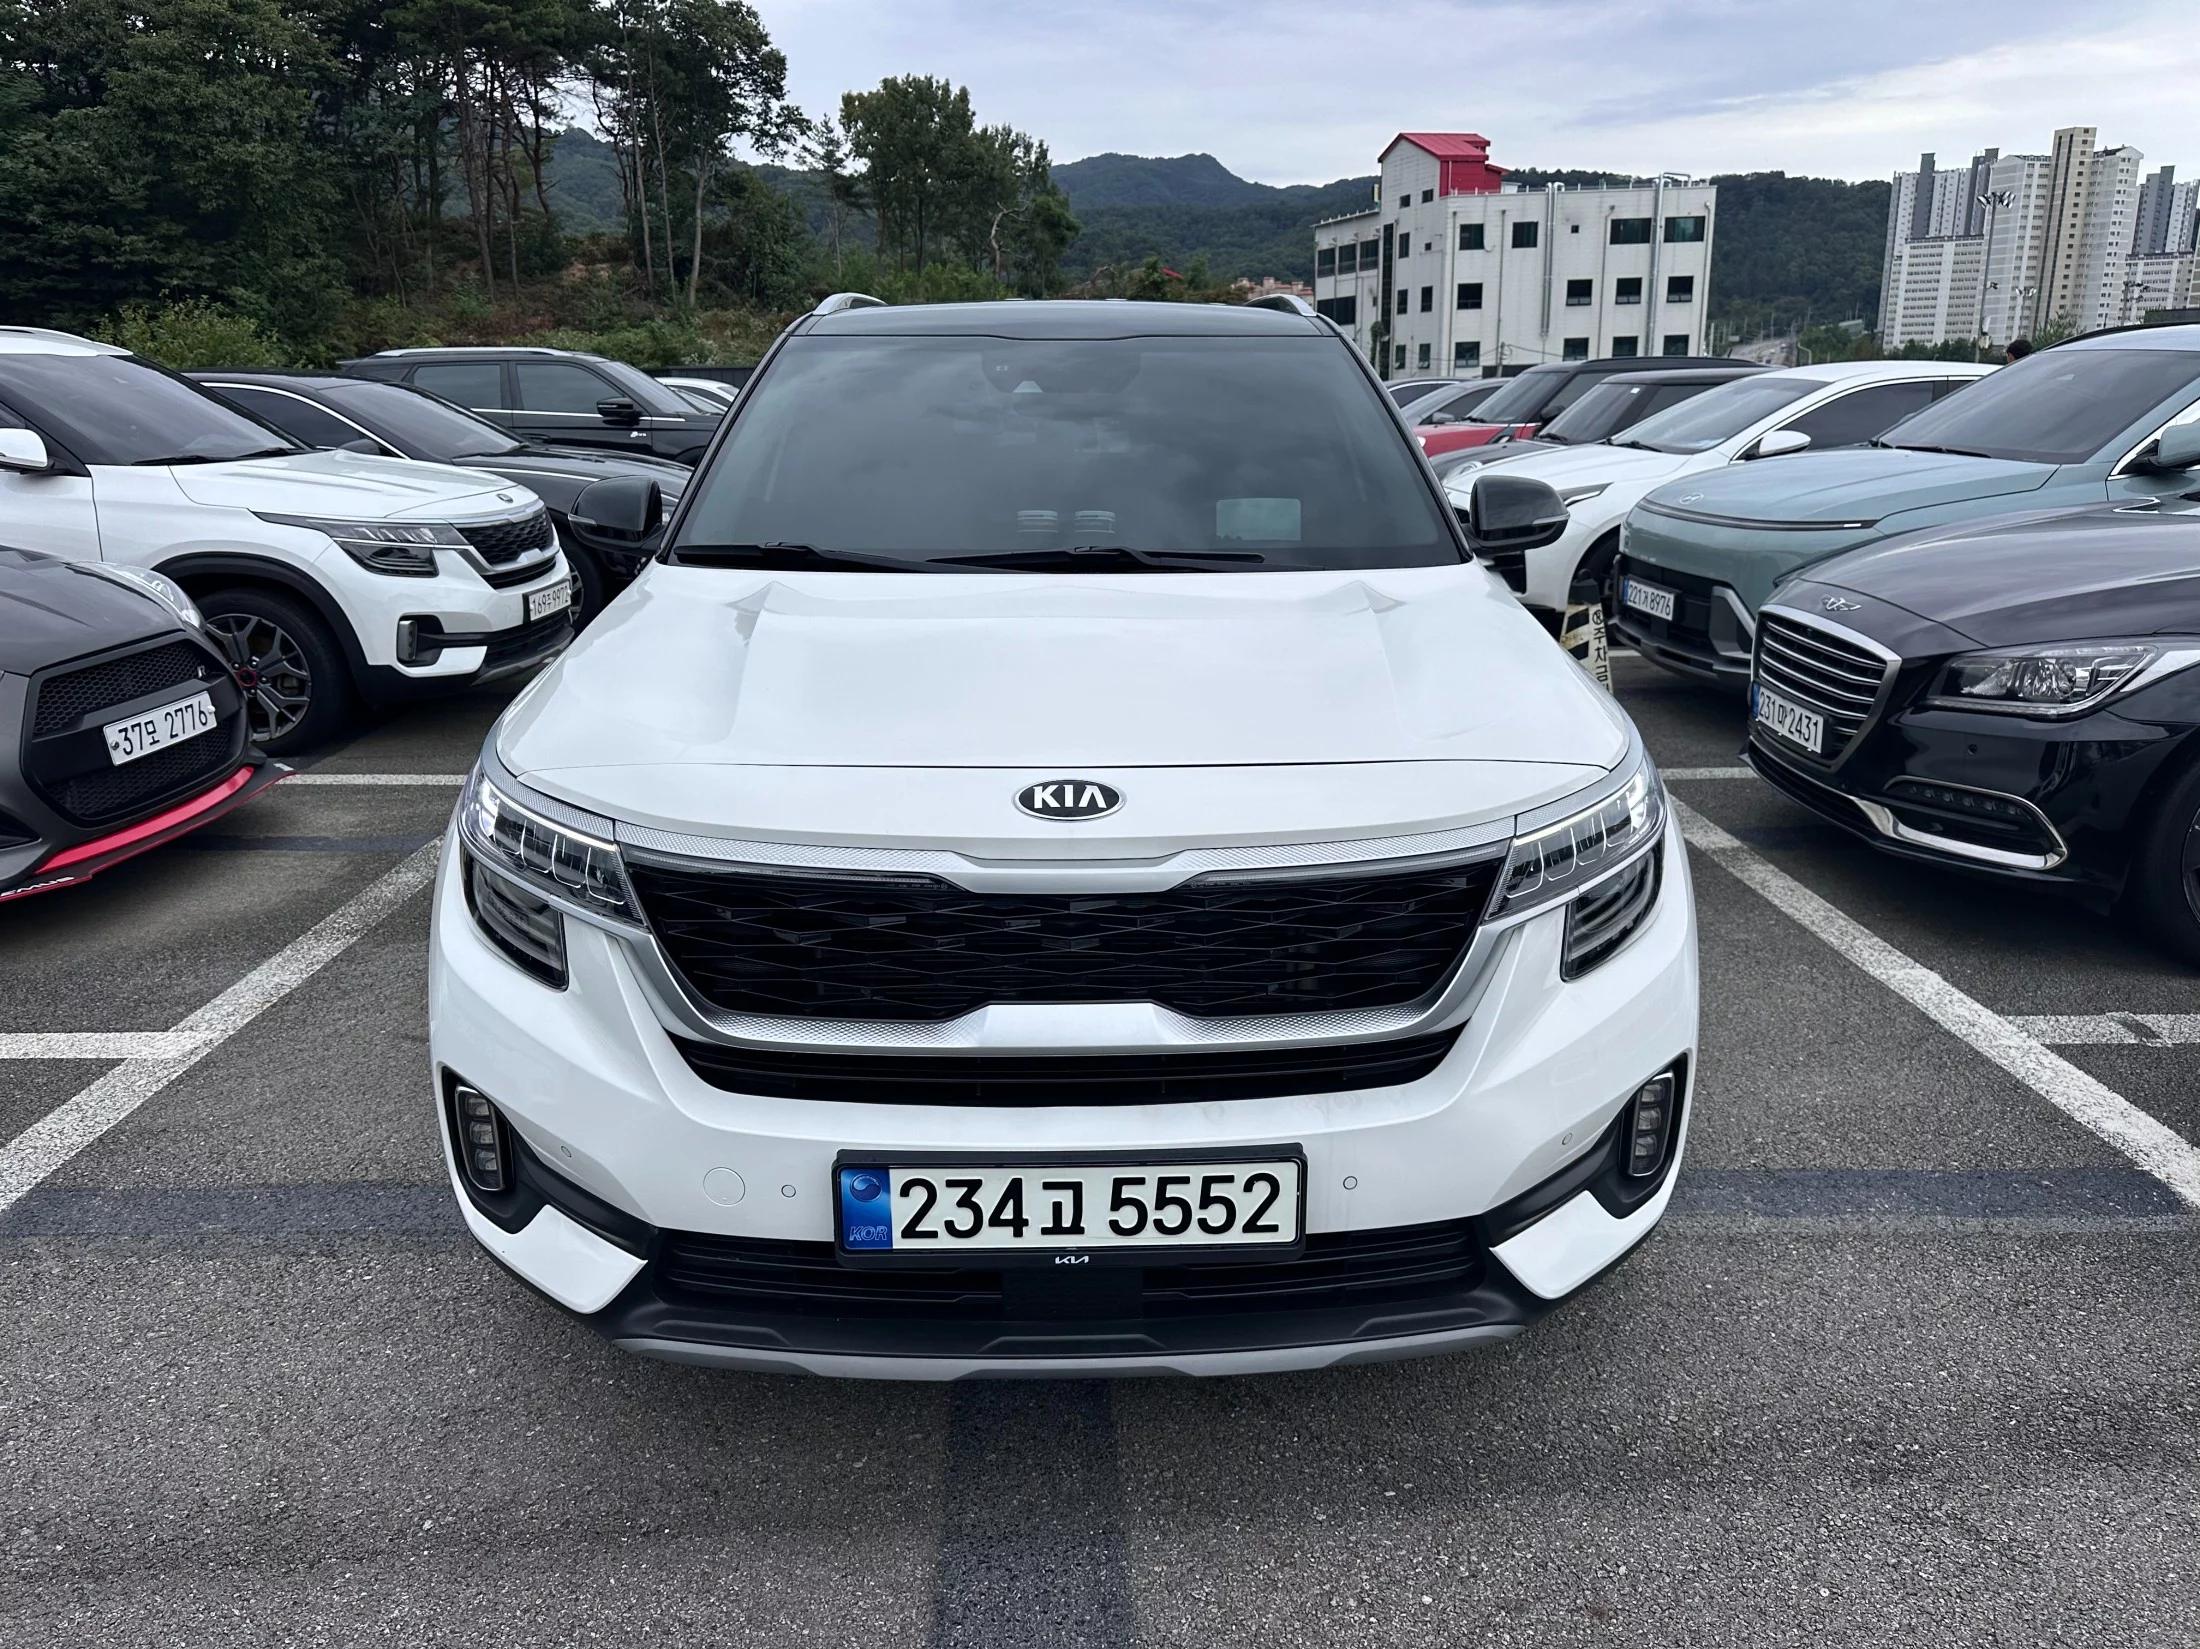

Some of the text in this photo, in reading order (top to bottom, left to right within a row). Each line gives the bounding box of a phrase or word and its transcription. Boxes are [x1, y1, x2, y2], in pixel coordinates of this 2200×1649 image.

[117, 701, 208, 756] 37모 2776
[1033, 784, 1107, 808] KIA
[899, 1172, 1281, 1240] 234고 5552
[849, 1225, 888, 1240] KOR
